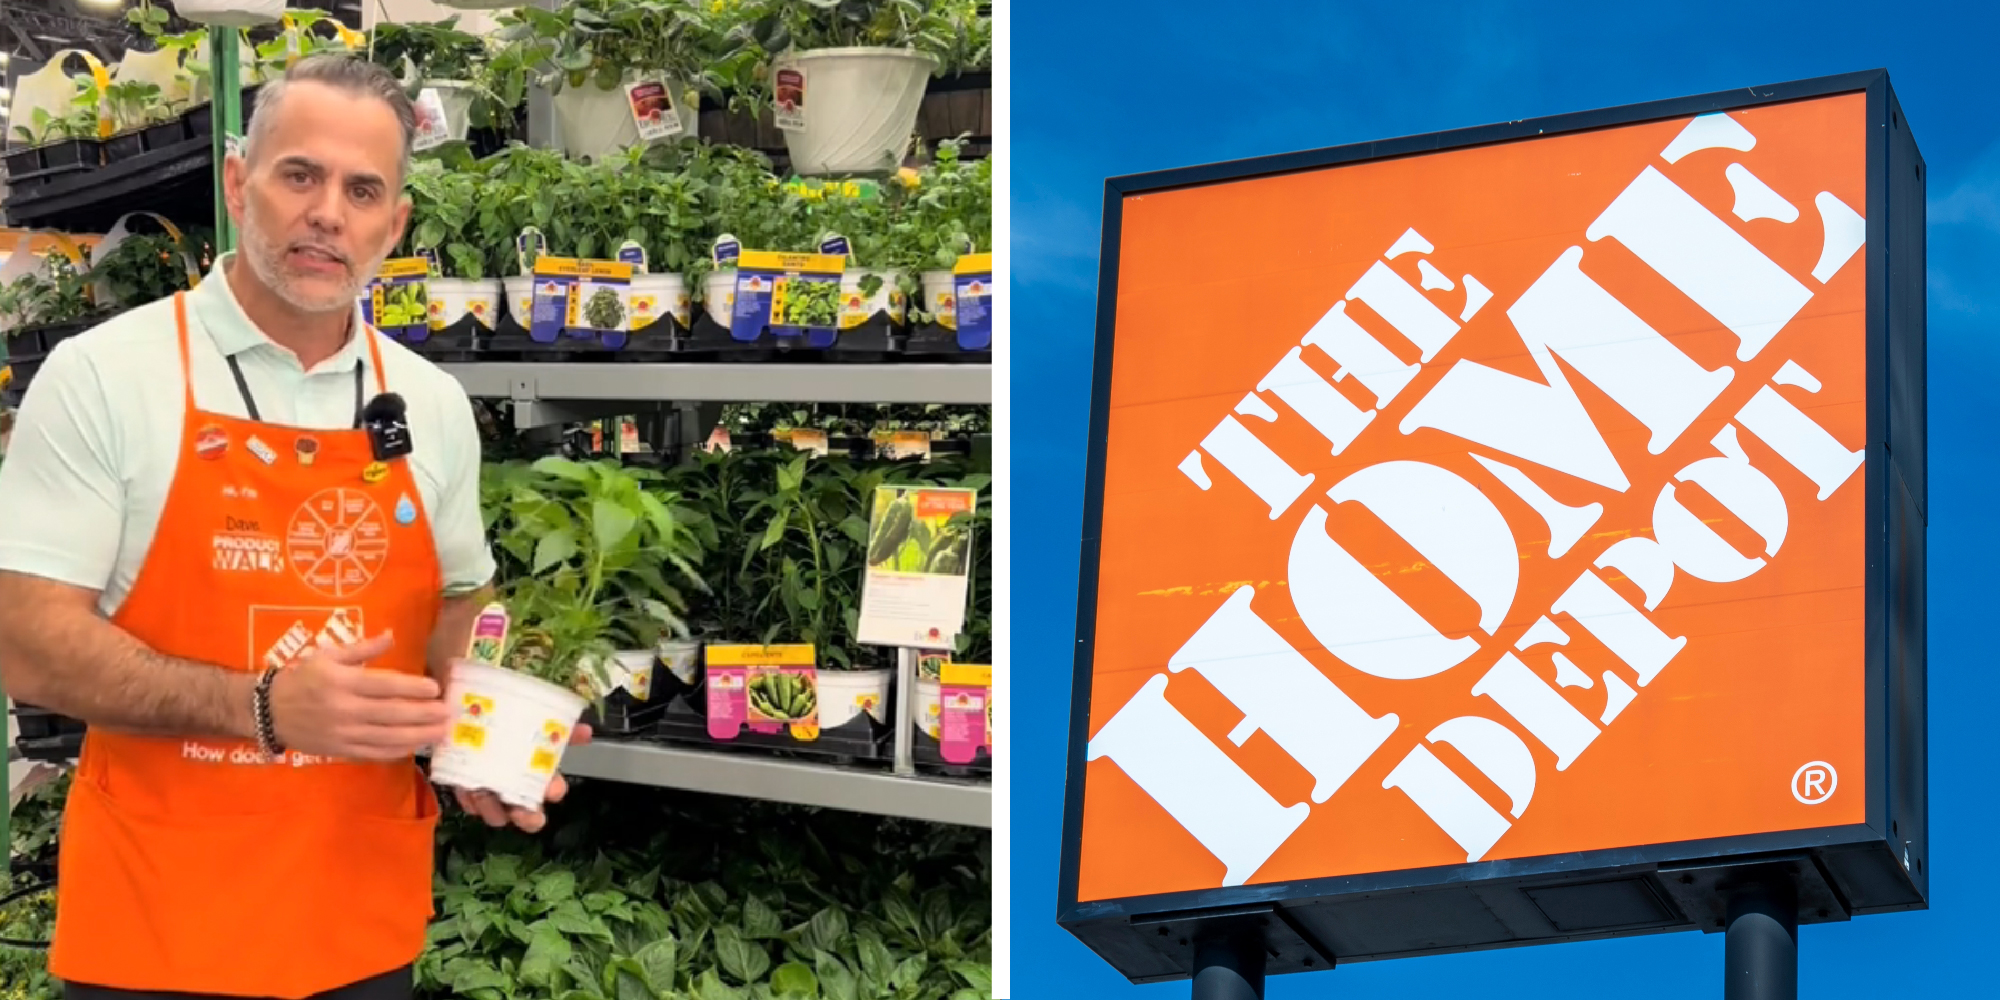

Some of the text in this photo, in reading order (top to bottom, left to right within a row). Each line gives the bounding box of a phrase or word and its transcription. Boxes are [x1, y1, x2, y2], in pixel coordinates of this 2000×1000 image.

[1178, 227, 1494, 520] THE
[1087, 112, 1866, 887] HOME
[225, 514, 260, 532] Dave
[213, 535, 280, 552] PRODUCT
[213, 549, 285, 573] WALK
[1382, 359, 1866, 862] DEPOT
[263, 620, 314, 668] THE
[182, 740, 225, 761] How
